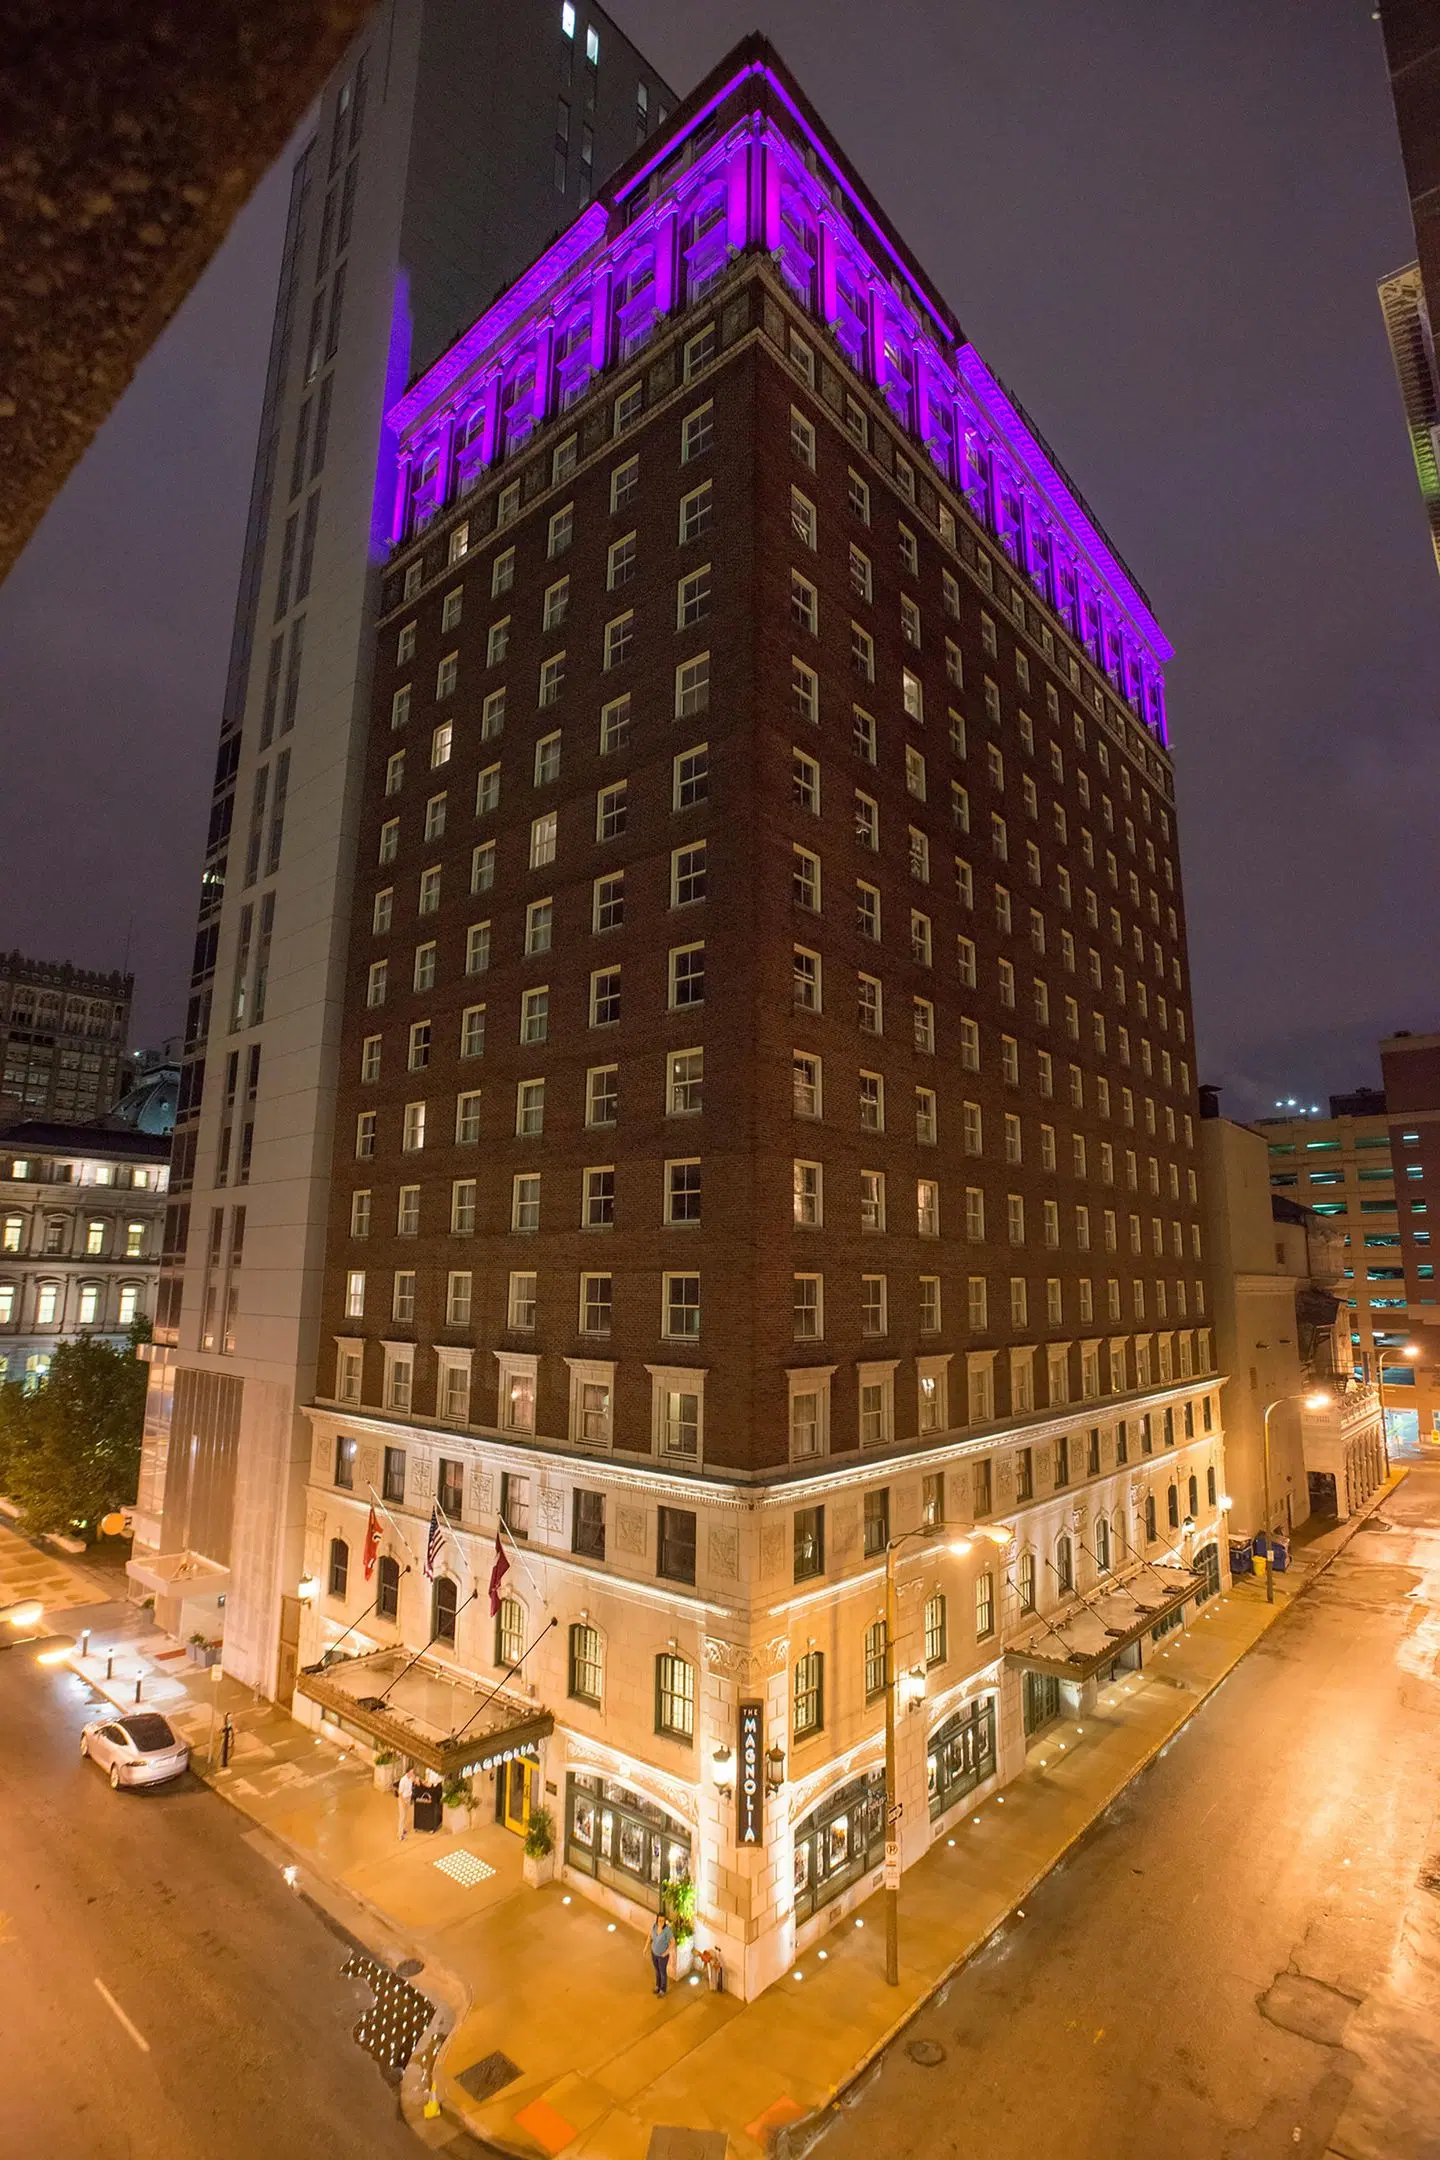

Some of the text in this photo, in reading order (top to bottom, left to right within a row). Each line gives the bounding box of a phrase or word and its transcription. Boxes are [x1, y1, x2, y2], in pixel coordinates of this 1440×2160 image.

[743, 1708, 758, 1716] THE
[461, 1742, 535, 1779] MAGNOLIA
[744, 1718, 757, 1843] MAGNOLIA
